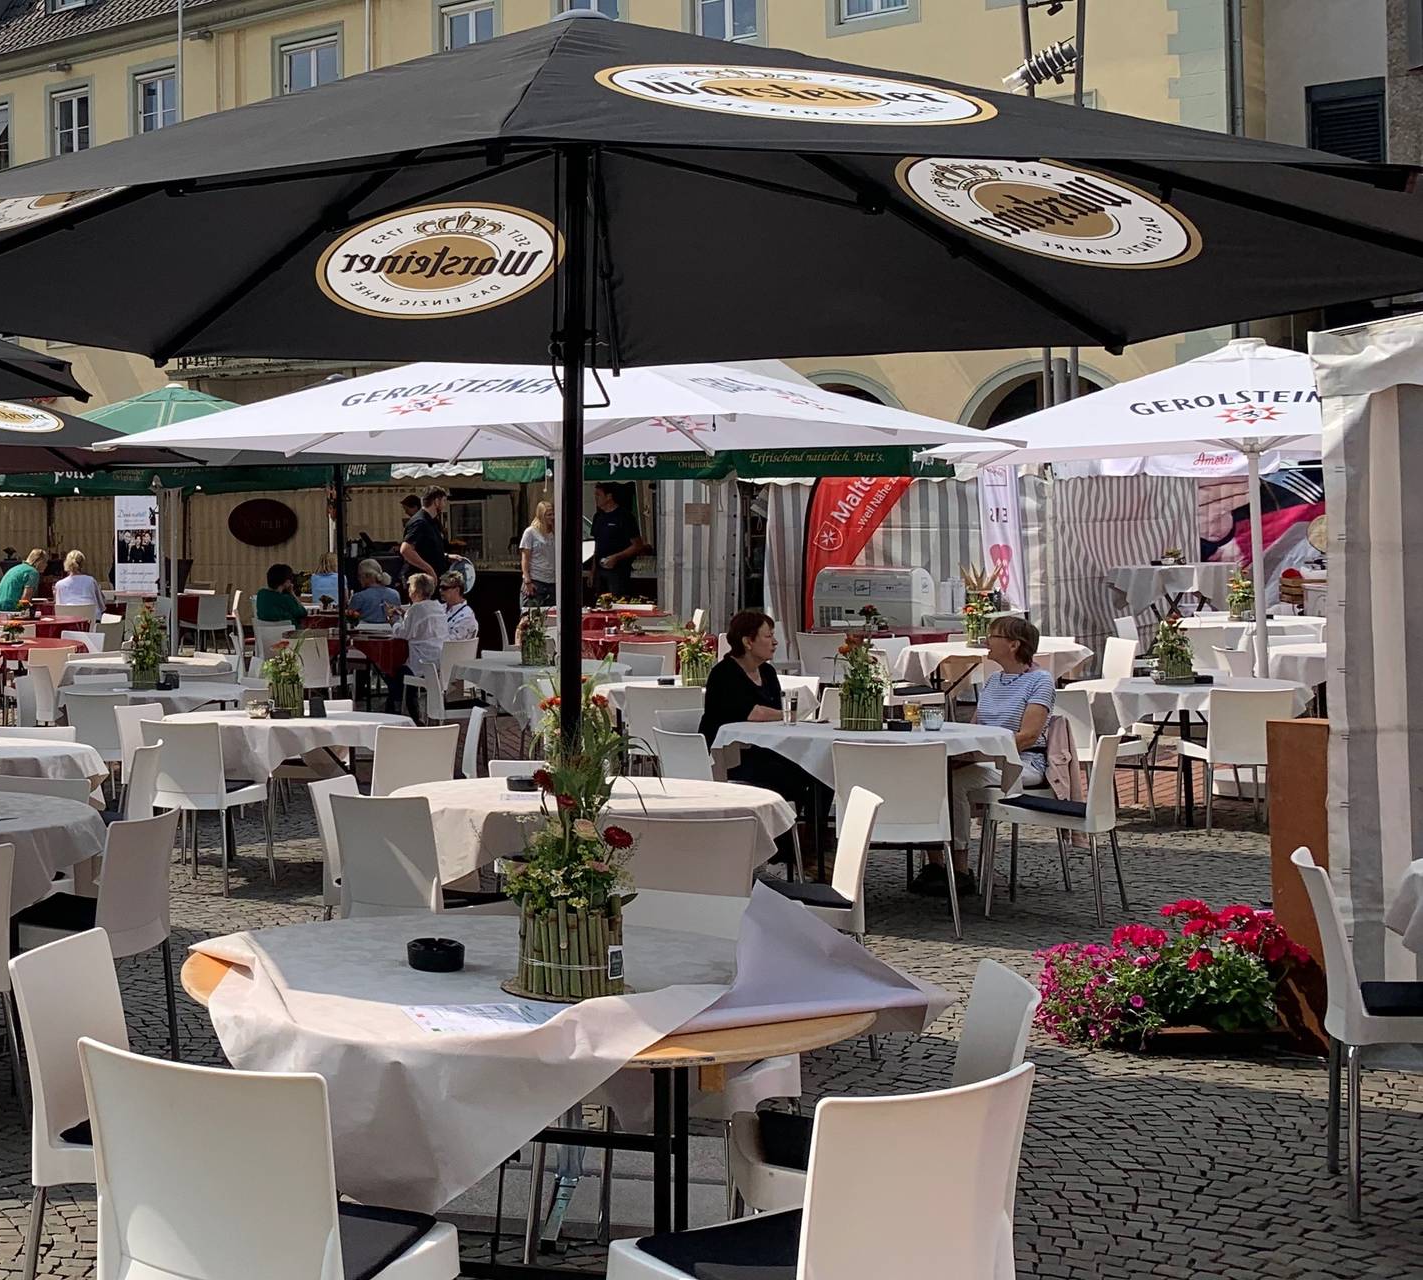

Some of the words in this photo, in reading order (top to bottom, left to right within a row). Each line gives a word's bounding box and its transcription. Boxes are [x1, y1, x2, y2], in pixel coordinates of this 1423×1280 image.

[628, 79, 948, 104] Warsteiner
[341, 377, 565, 407] GEROLSTEINER
[609, 452, 657, 475] Pott's
[750, 452, 803, 466] Erfrischend
